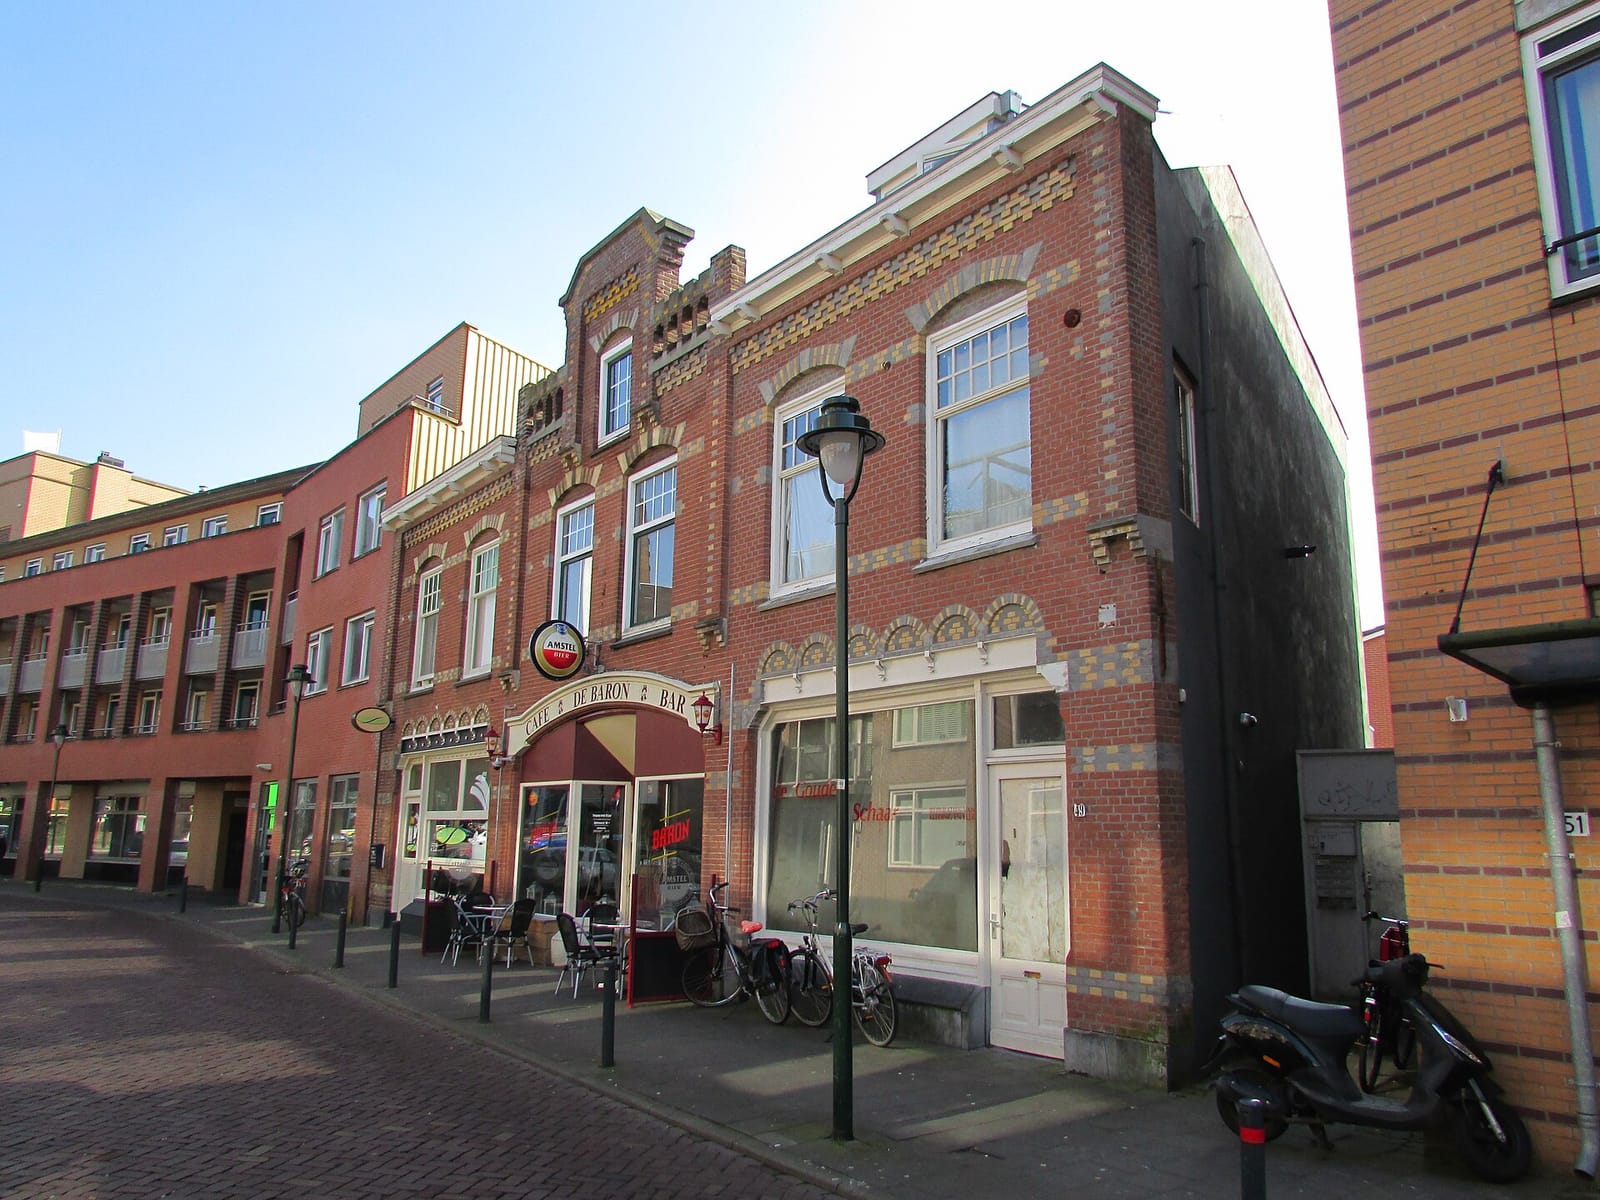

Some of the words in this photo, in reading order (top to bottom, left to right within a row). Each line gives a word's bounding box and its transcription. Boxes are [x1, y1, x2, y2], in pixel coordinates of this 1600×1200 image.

[546, 641, 577, 652] AMSTEL
[553, 651, 570, 659] BIER
[573, 689, 587, 707] DE
[590, 682, 631, 702] BARON
[659, 688, 687, 715] BAR
[652, 817, 691, 850] BARON
[1564, 815, 1584, 834] 51
